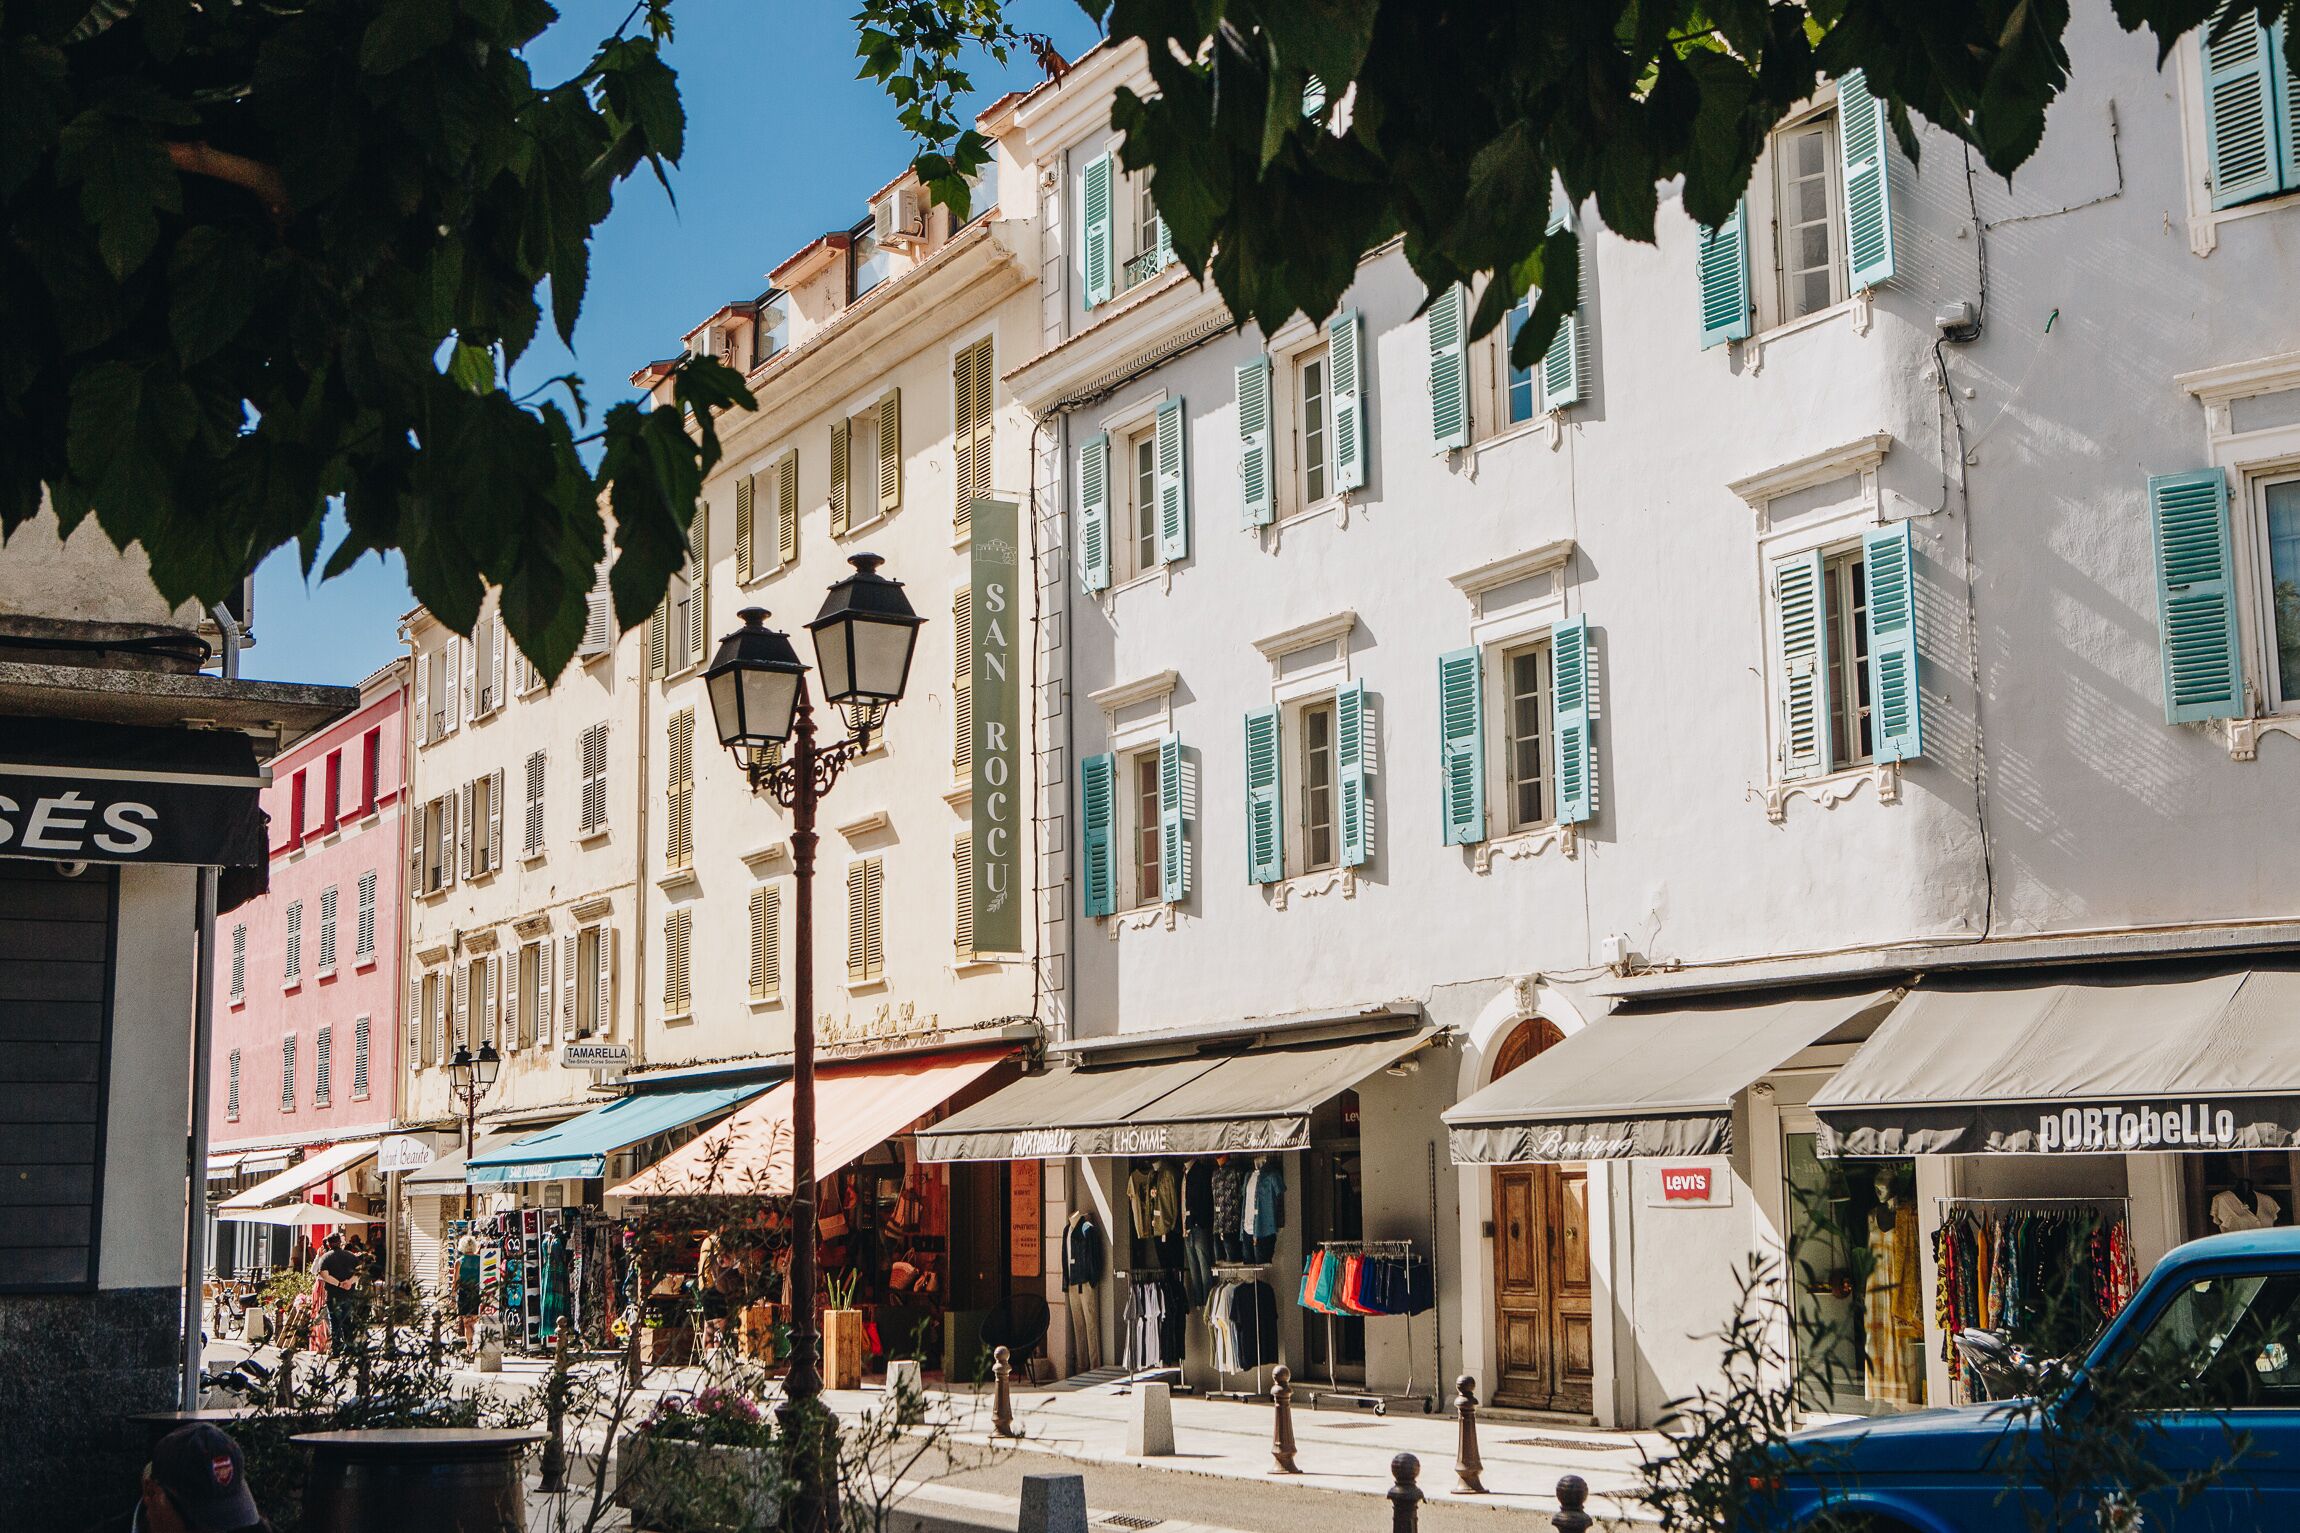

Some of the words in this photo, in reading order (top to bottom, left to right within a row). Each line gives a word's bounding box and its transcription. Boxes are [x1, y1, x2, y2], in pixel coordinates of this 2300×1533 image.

[982, 583, 1008, 682] SAN
[984, 721, 1009, 893] ROCCU
[568, 1048, 627, 1058] TAMARELLA
[400, 1139, 430, 1165] Beauté
[1113, 1129, 1167, 1152] L'HOMME
[1533, 1130, 1633, 1158] Boutique
